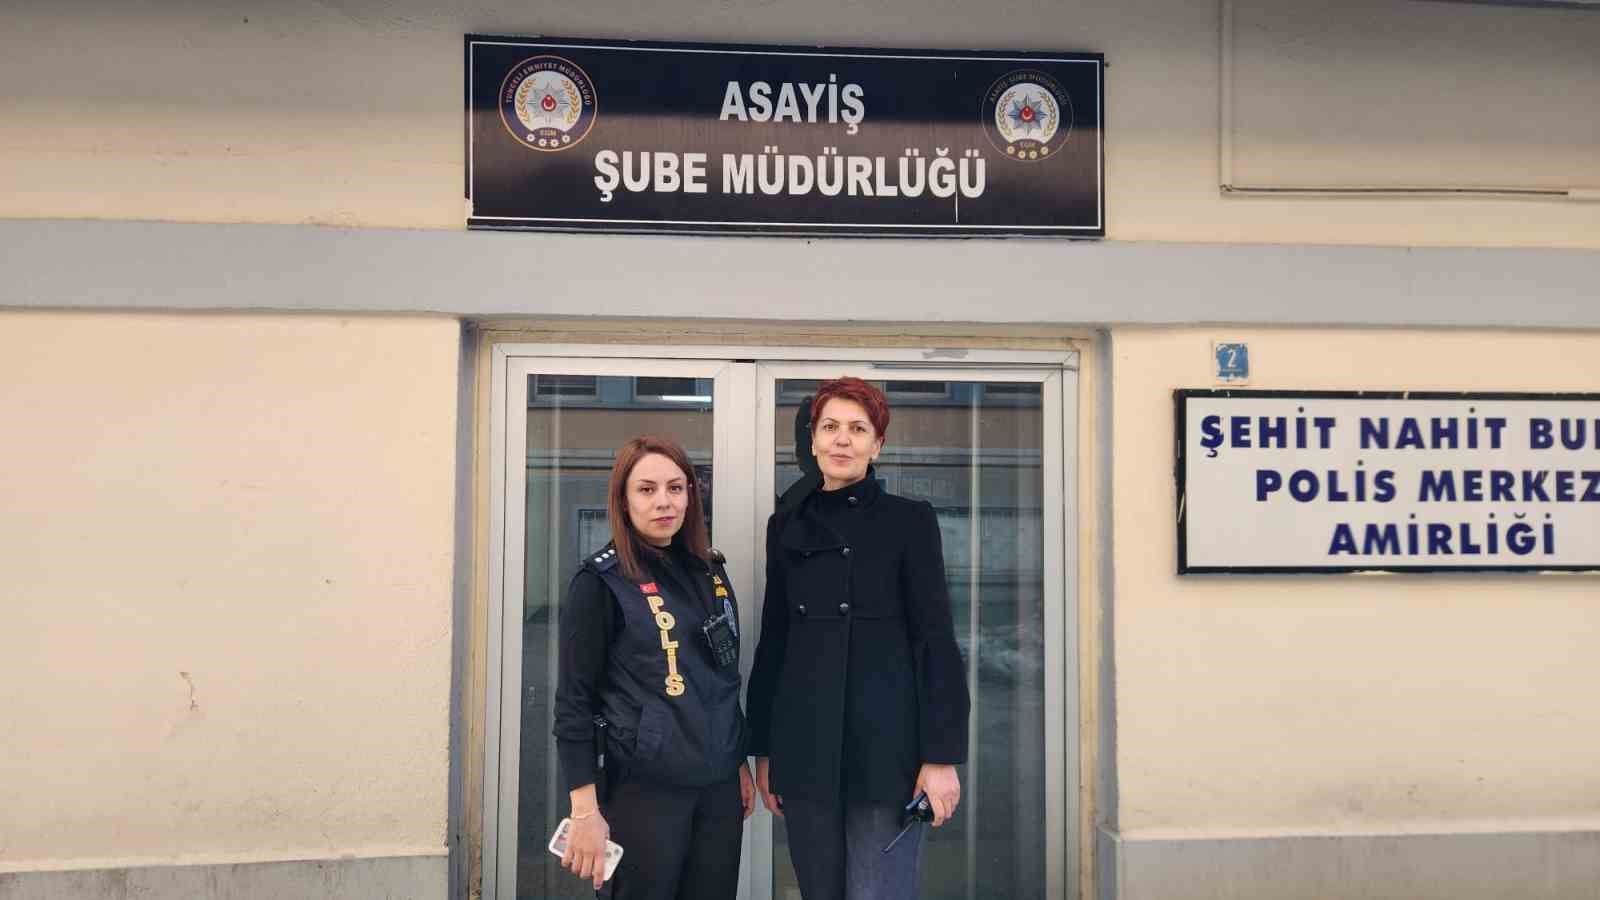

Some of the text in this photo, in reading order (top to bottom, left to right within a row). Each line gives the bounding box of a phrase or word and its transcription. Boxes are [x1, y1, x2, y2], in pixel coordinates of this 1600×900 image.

[720, 73, 865, 135] ASAYİŞ
[594, 146, 986, 202] ŞUBE MÜDÜRLÜĞÜ
[1227, 349, 1237, 368] 2
[1200, 406, 1600, 458] ŞEHİT NAHİT BU
[1256, 460, 1600, 502] POLİS MERKEZ
[1328, 513, 1555, 555] AMİRLİĞİ
[647, 595, 686, 696] POLİS
